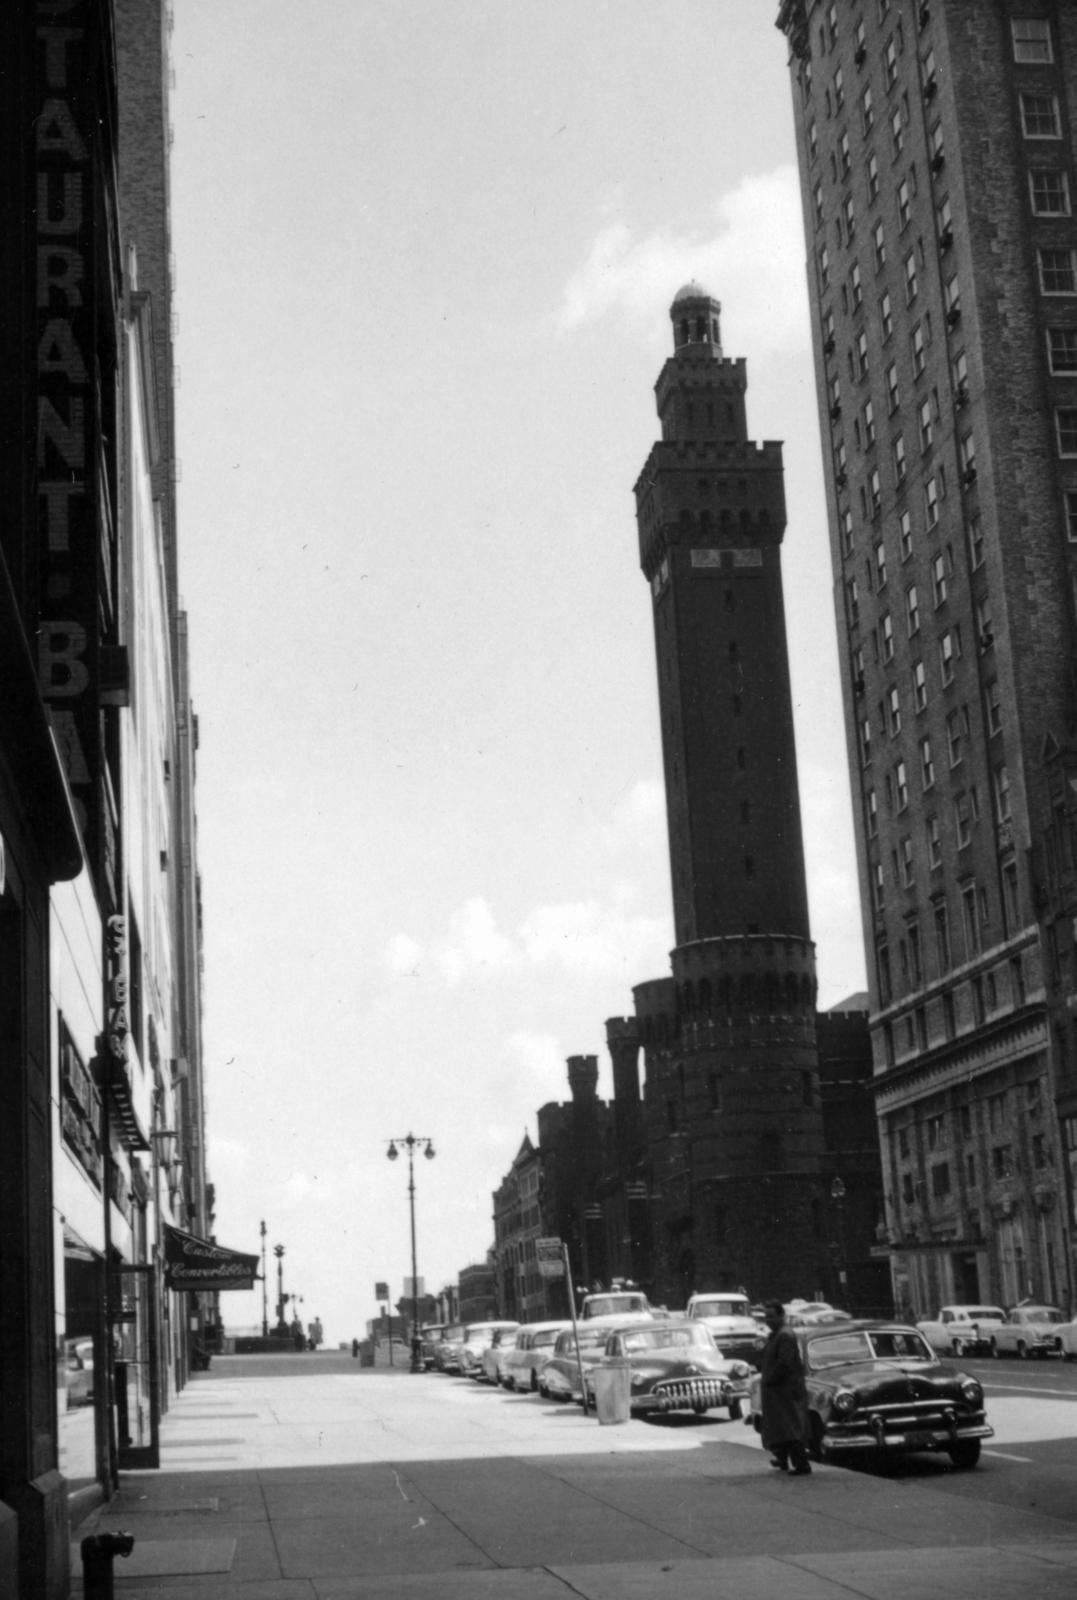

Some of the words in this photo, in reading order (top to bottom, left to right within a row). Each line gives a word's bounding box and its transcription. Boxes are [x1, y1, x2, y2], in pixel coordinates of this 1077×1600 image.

[36, 0, 90, 551] TAURANT
[182, 1240, 232, 1259] Custom
[171, 1262, 251, 1278] Convertibles
